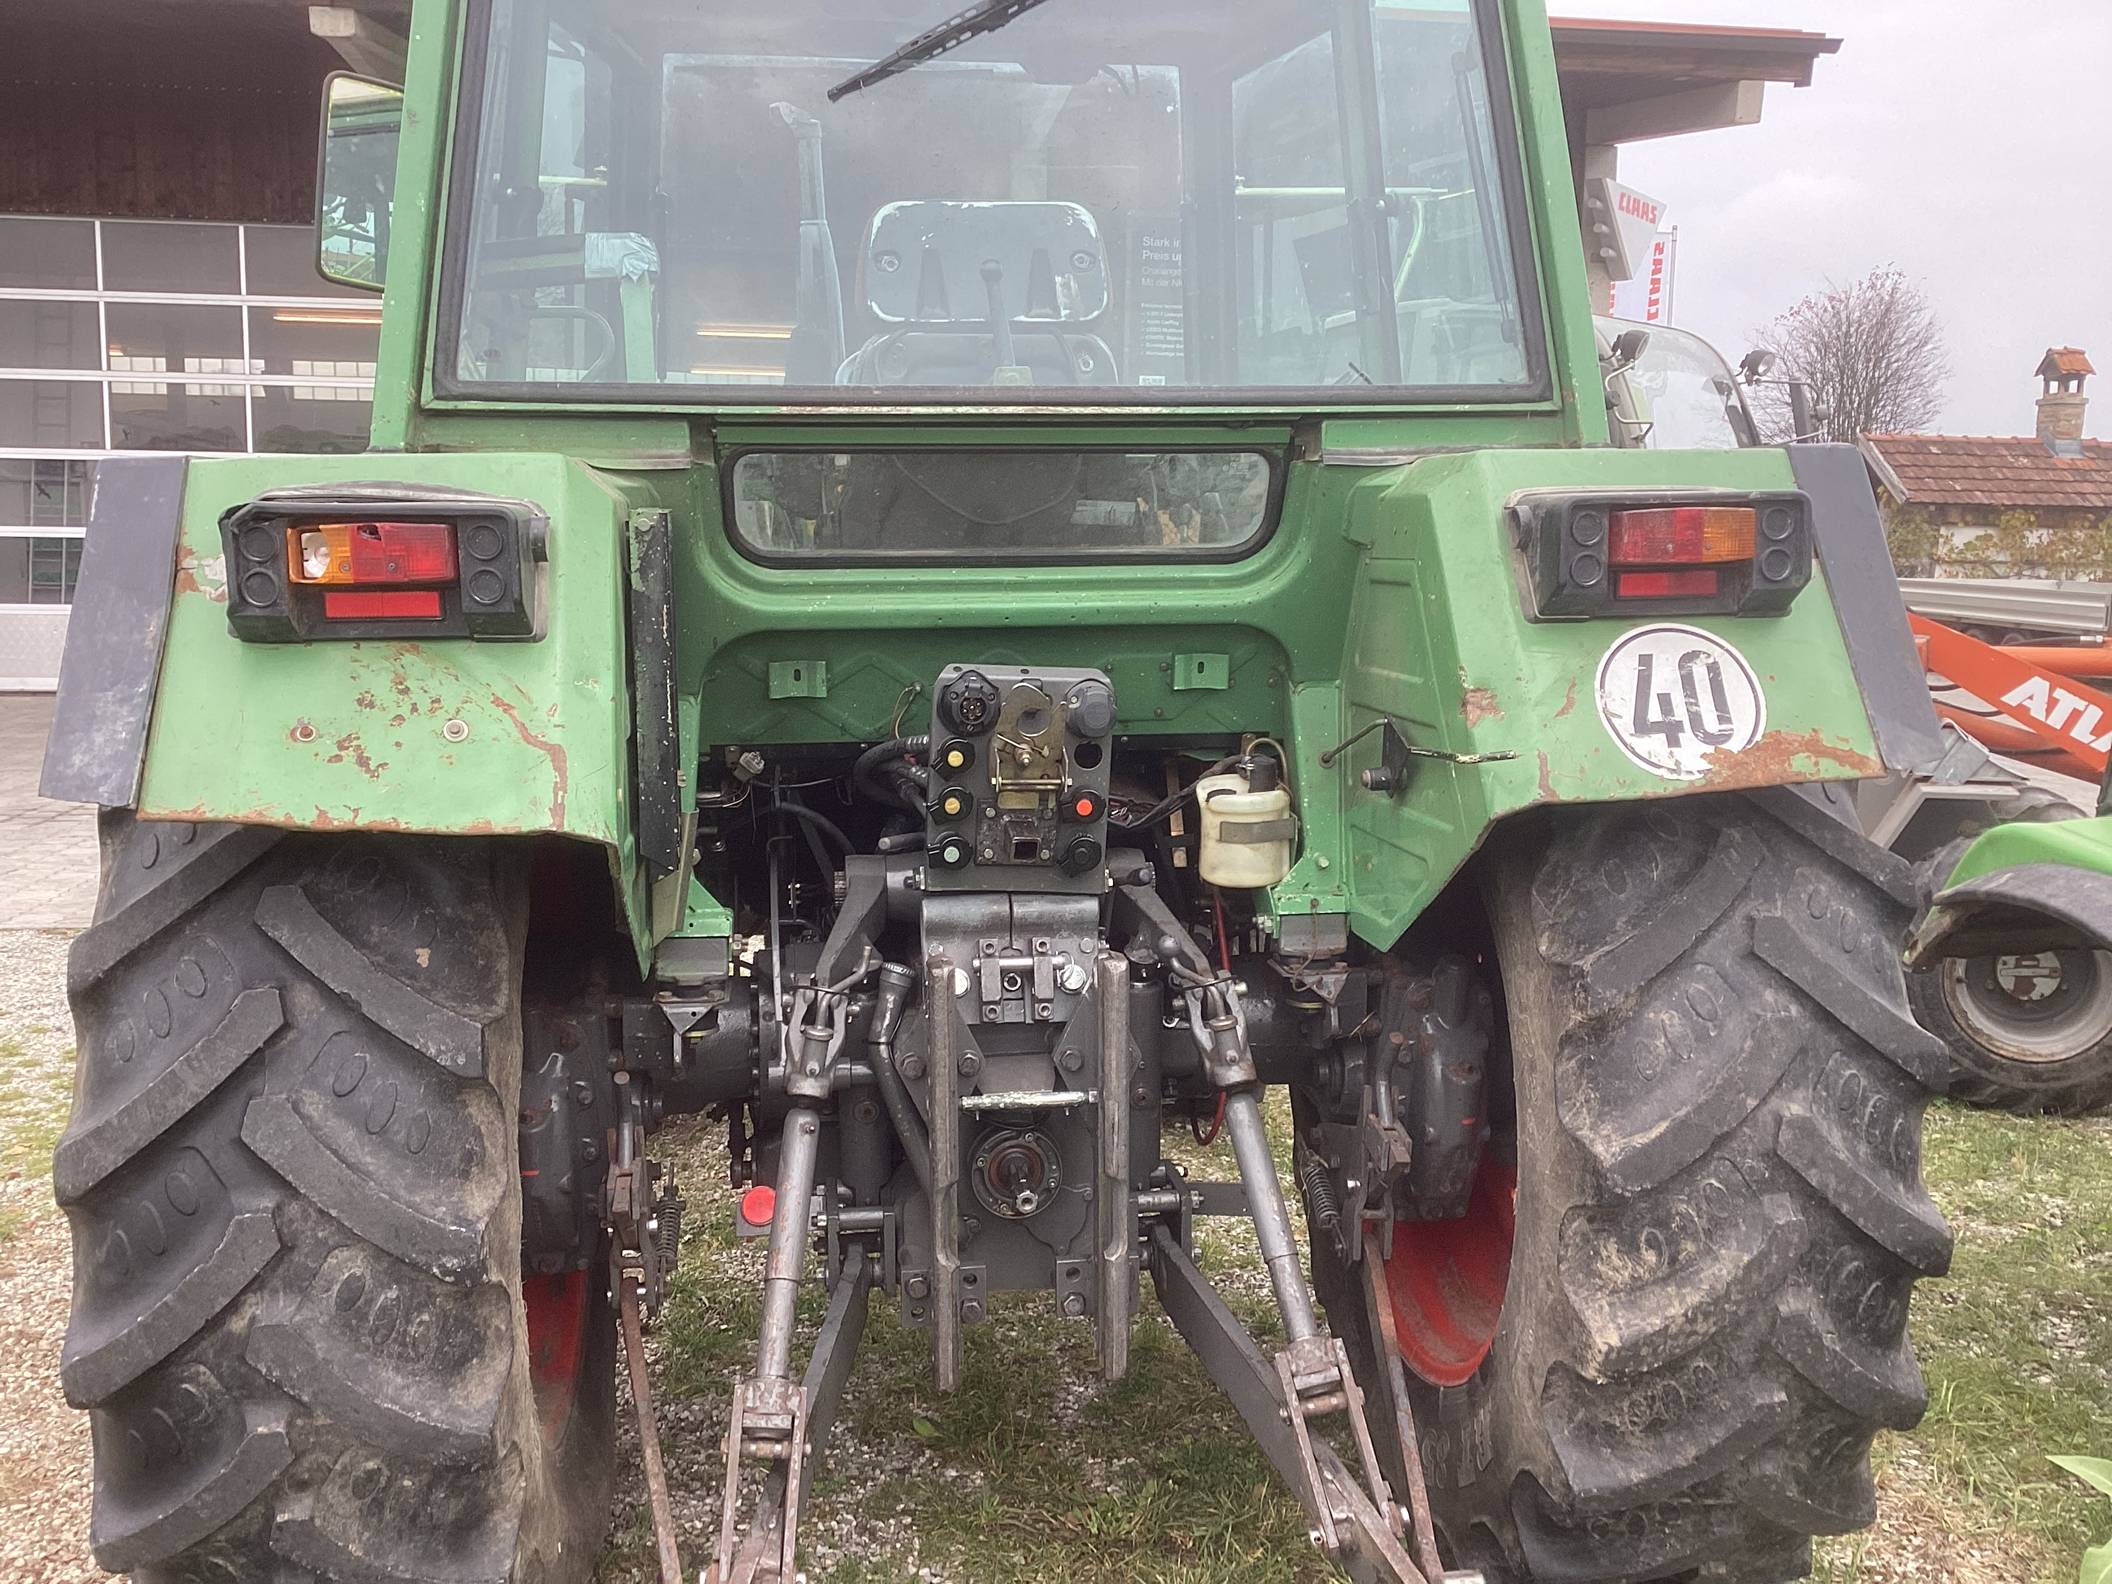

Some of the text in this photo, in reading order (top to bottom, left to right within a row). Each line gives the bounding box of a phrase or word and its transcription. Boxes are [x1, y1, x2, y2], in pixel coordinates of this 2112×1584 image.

[1618, 191, 1658, 225] CLAAS
[1142, 236, 1170, 248] Stark
[1142, 250, 1170, 260] Preis
[1633, 649, 1735, 748] 40
